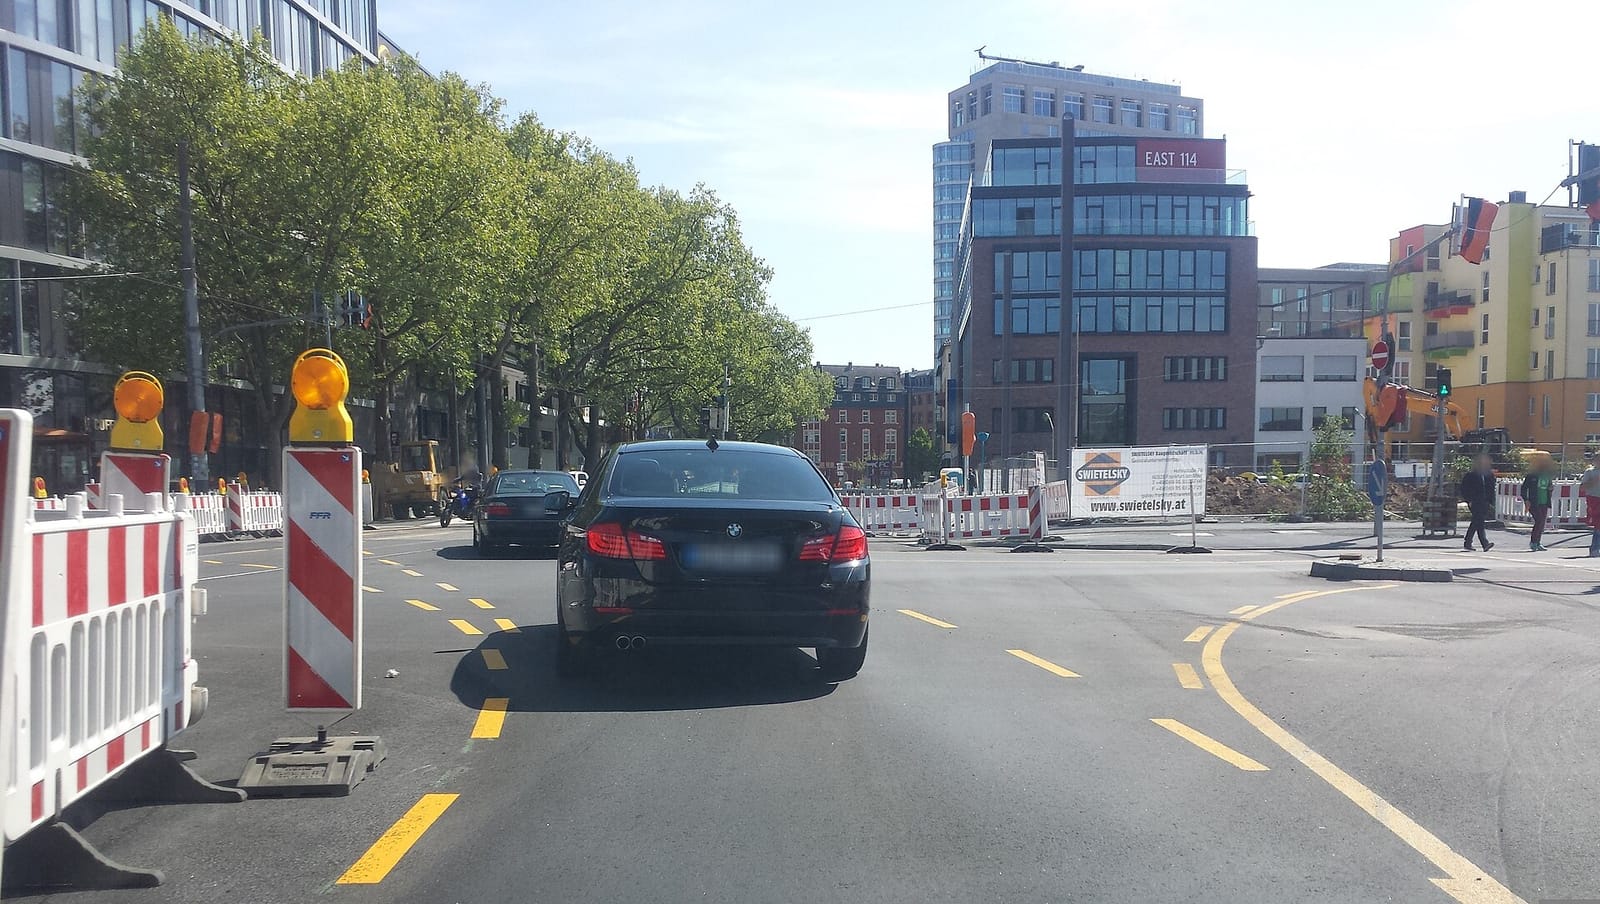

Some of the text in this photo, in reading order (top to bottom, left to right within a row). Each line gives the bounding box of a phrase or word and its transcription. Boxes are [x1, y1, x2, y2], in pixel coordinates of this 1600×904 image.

[1145, 151, 1197, 167] EAST 114
[1077, 469, 1128, 480] SWIETELSKY
[1090, 498, 1186, 512] www.swietelsky.at
